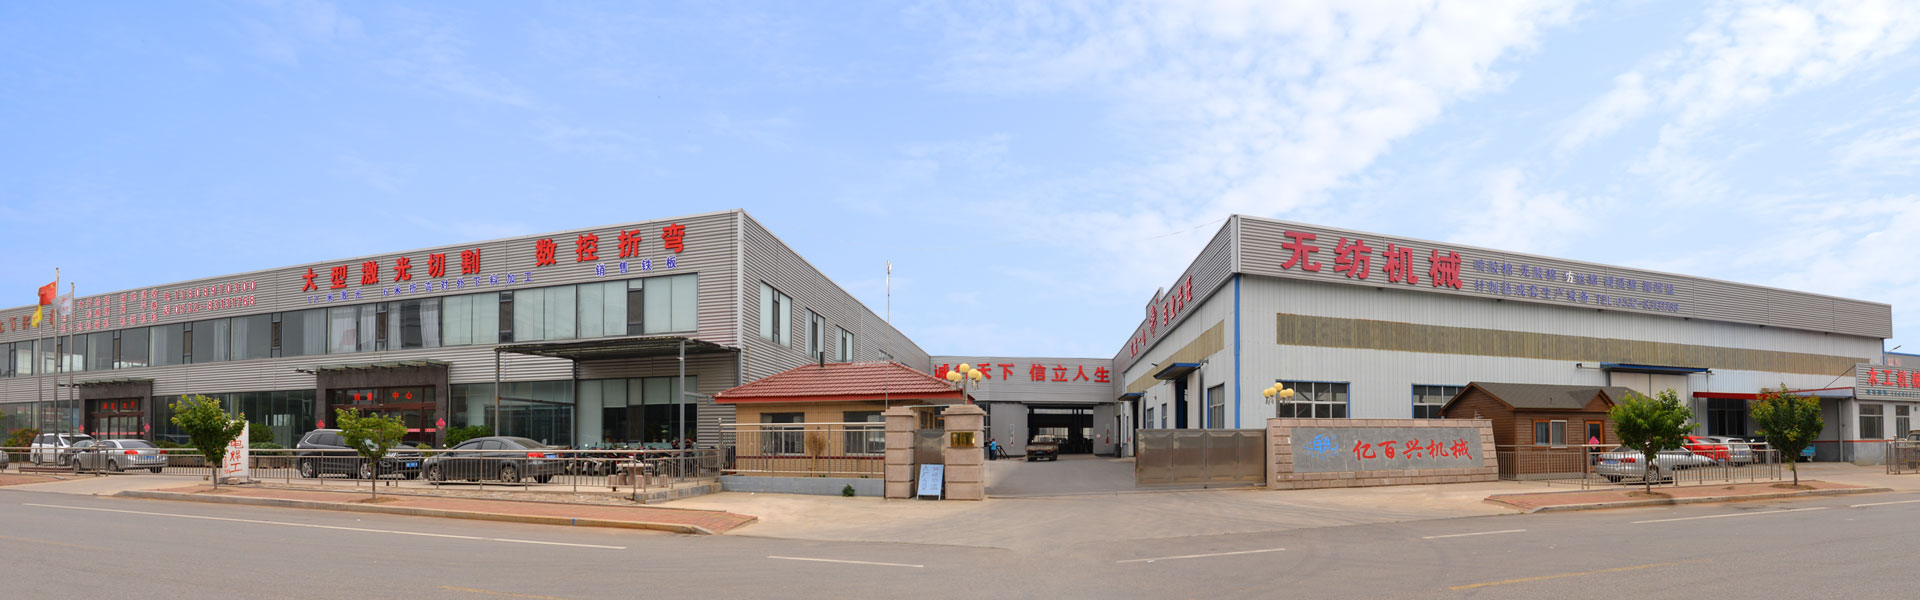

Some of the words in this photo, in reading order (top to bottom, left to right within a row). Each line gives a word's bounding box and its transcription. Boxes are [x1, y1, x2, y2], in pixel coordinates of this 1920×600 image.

[302, 248, 481, 292] 大型激光切割
[536, 222, 686, 268] 数控折弯
[595, 256, 677, 277] 销售铁板
[1280, 230, 1464, 290] 无纺机械
[174, 280, 256, 301] 13808970300
[174, 295, 256, 315] 0532-83131768
[1029, 363, 1111, 383] 信立人生
[1352, 437, 1473, 462] 亿百兴机械
